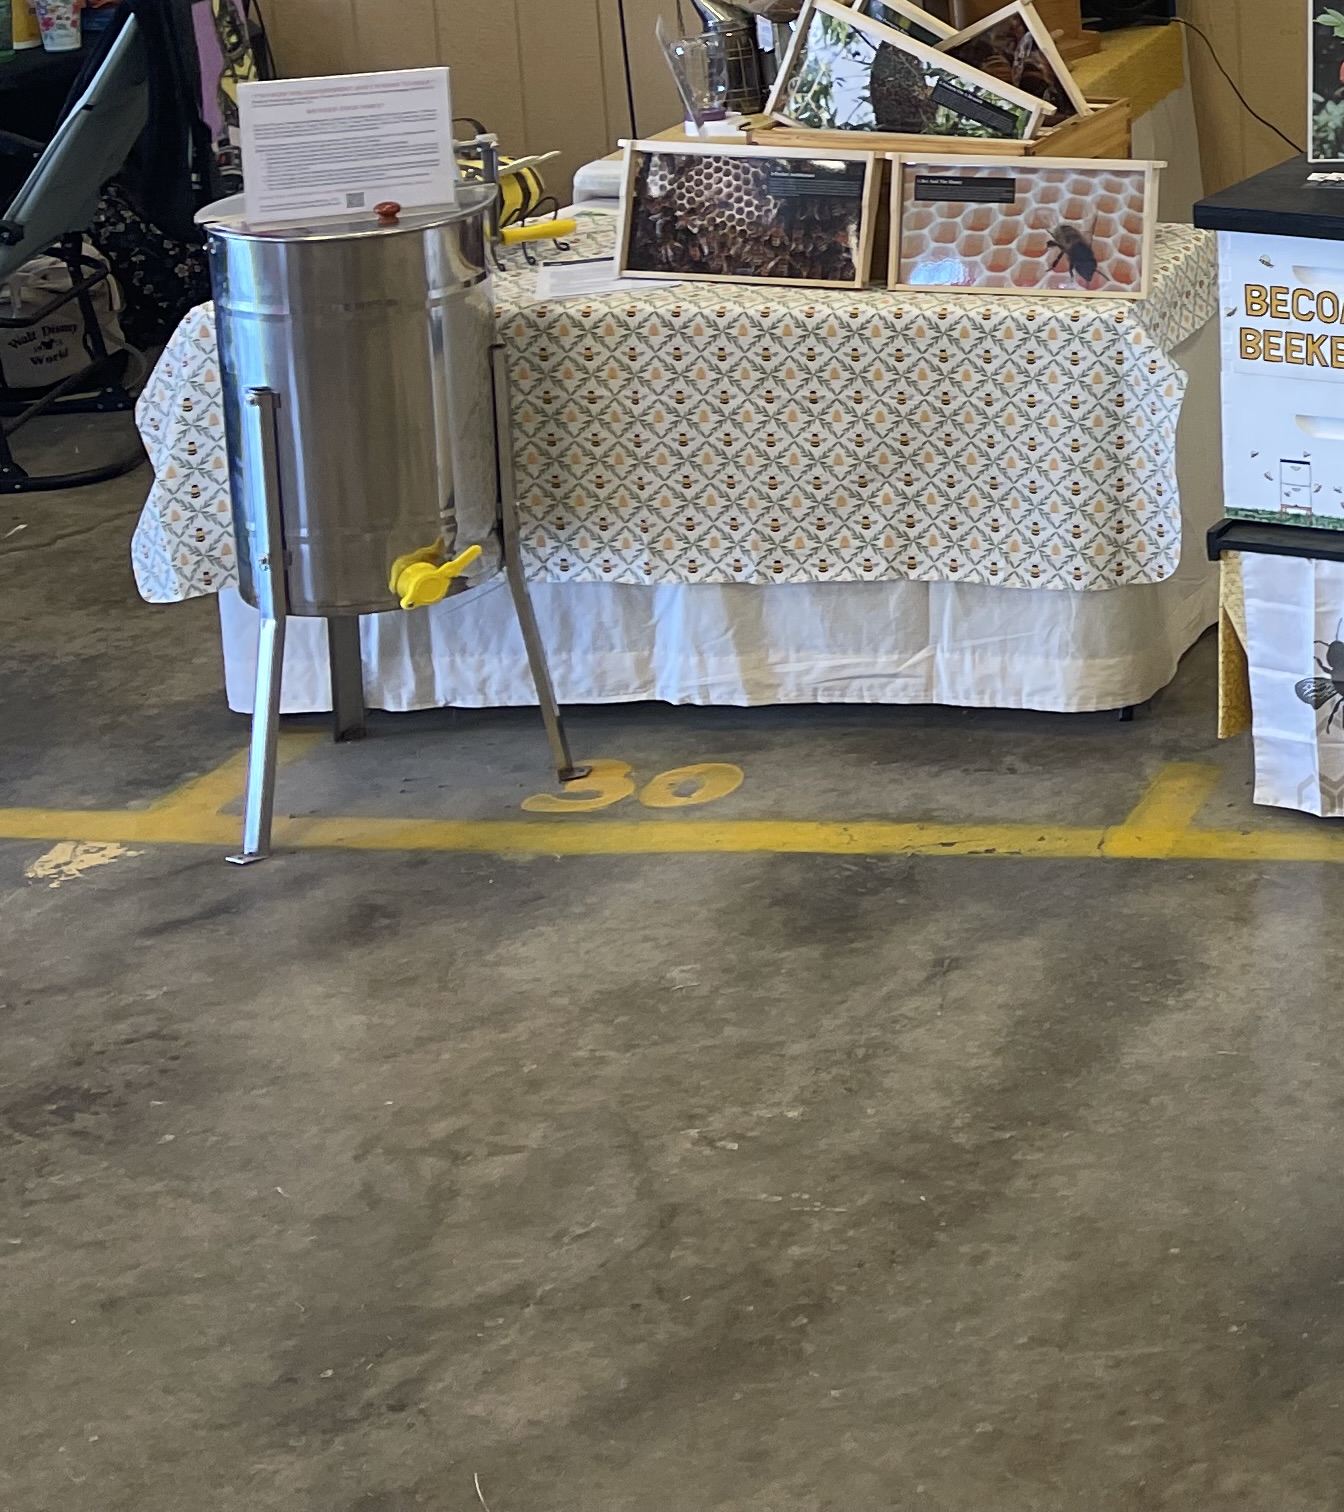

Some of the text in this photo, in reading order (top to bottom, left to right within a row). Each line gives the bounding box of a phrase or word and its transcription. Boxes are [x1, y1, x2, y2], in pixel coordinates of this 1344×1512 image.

[8, 330, 37, 348] Walt
[41, 324, 78, 337] Disney
[31, 347, 69, 365] World
[521, 758, 745, 813] 30
